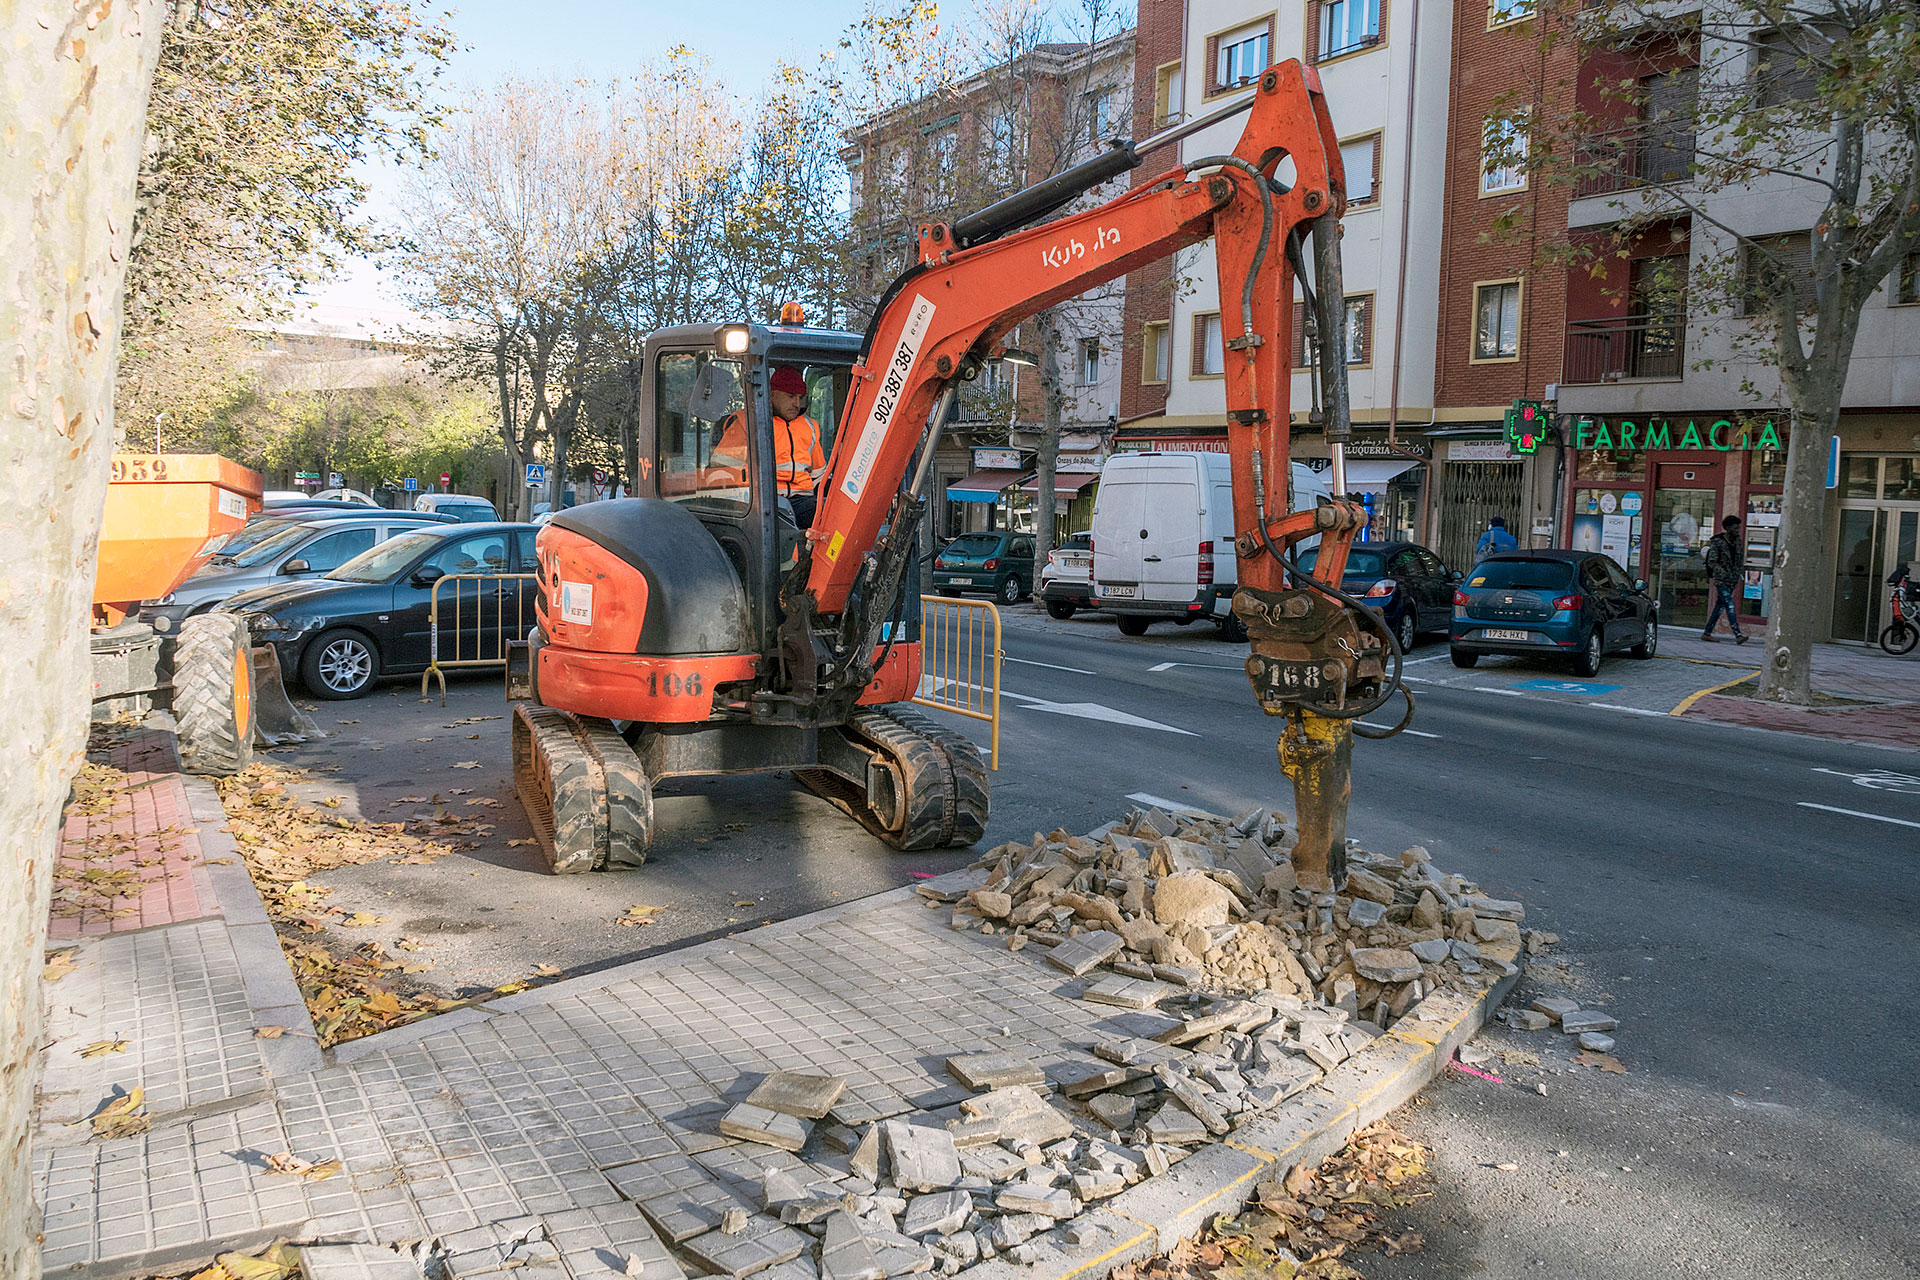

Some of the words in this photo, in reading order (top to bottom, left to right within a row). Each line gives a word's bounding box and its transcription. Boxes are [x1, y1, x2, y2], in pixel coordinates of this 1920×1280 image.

[1041, 226, 1121, 268] Kubta
[874, 395, 894, 425] 902
[884, 368, 903, 398] 387
[895, 341, 914, 371] 387
[1156, 440, 1228, 453] ALIMENTACIÓN
[1576, 419, 1781, 452] FARMACIA
[851, 431, 878, 482] Rentaire
[1344, 446, 1391, 456] ELUQUERIA
[1488, 630, 1508, 639] 1734
[1509, 631, 1525, 639] HXL
[647, 671, 703, 697] 106
[1268, 663, 1321, 688] 168
